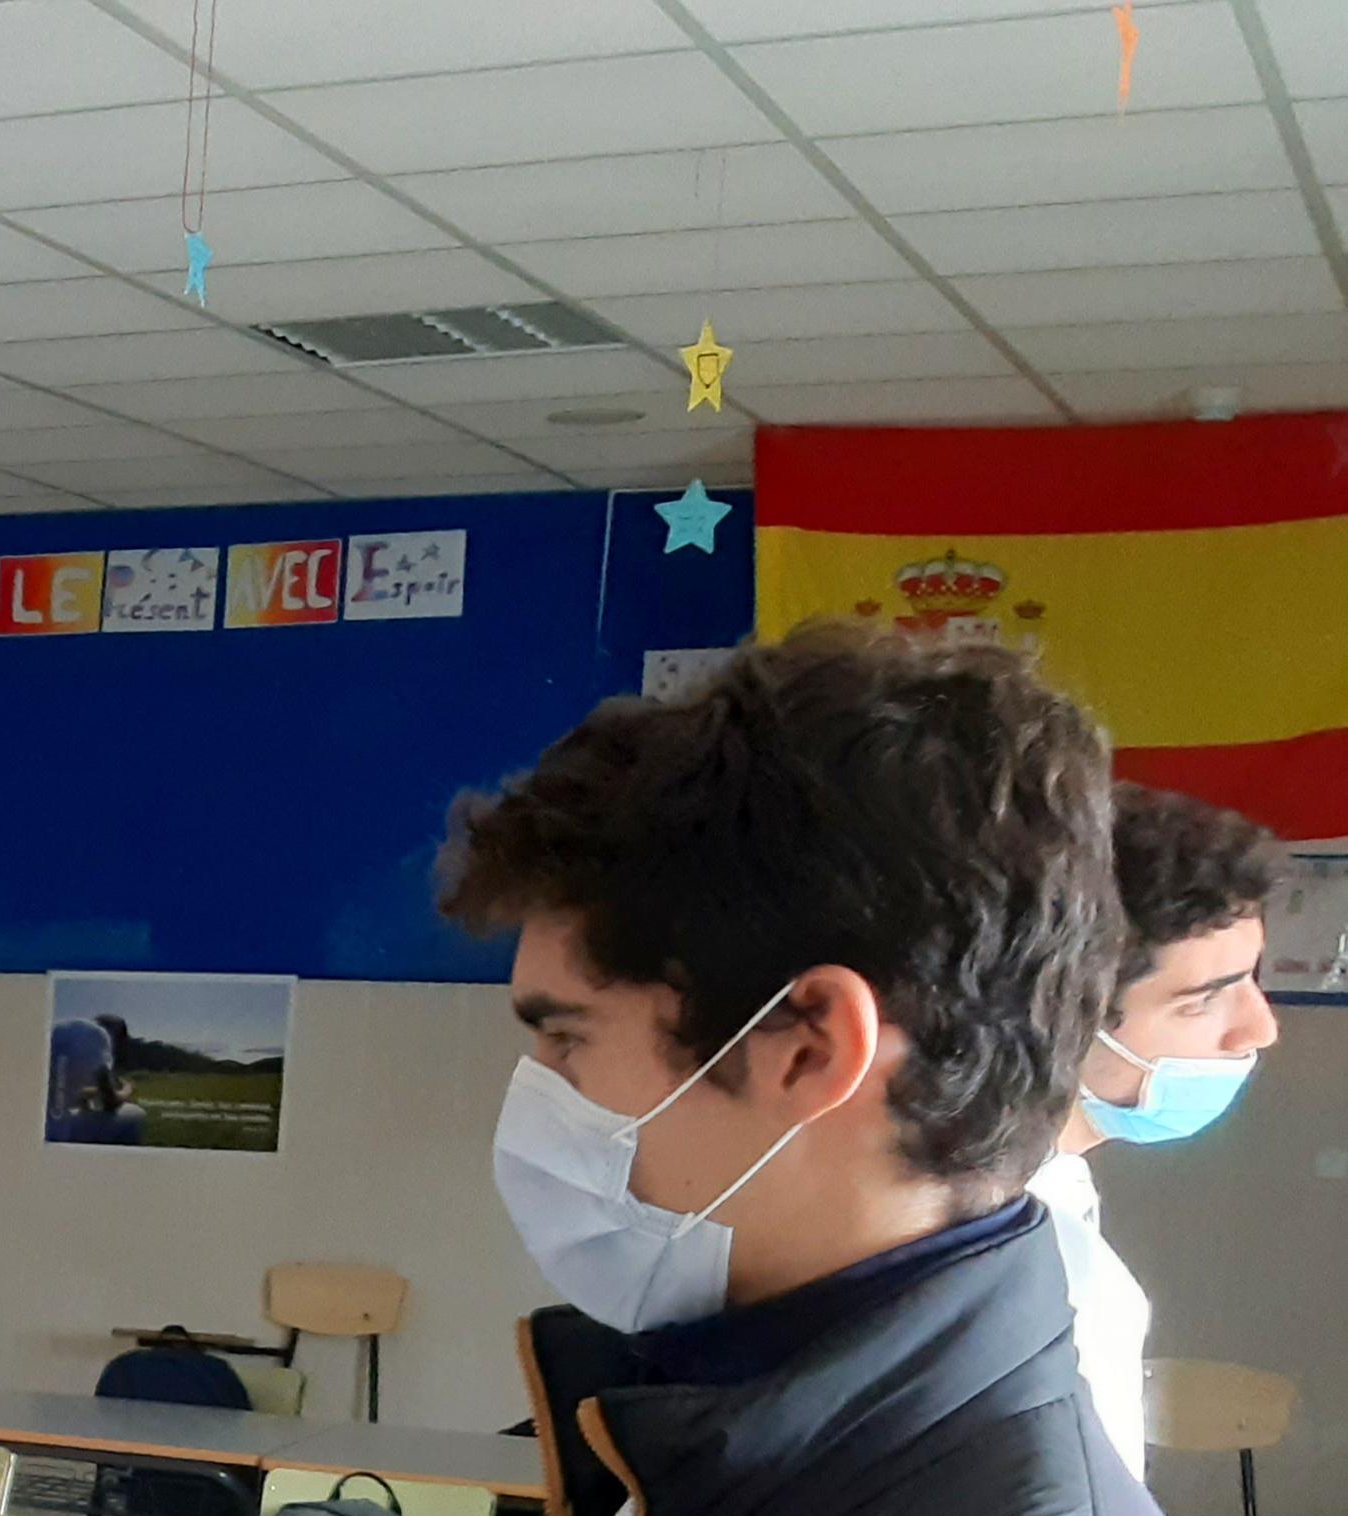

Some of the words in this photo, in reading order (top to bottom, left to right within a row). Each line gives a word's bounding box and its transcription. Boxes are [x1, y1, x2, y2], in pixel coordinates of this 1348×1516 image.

[11, 566, 92, 624] LE
[230, 549, 334, 613] AVEC
[350, 541, 461, 606] Espoir
